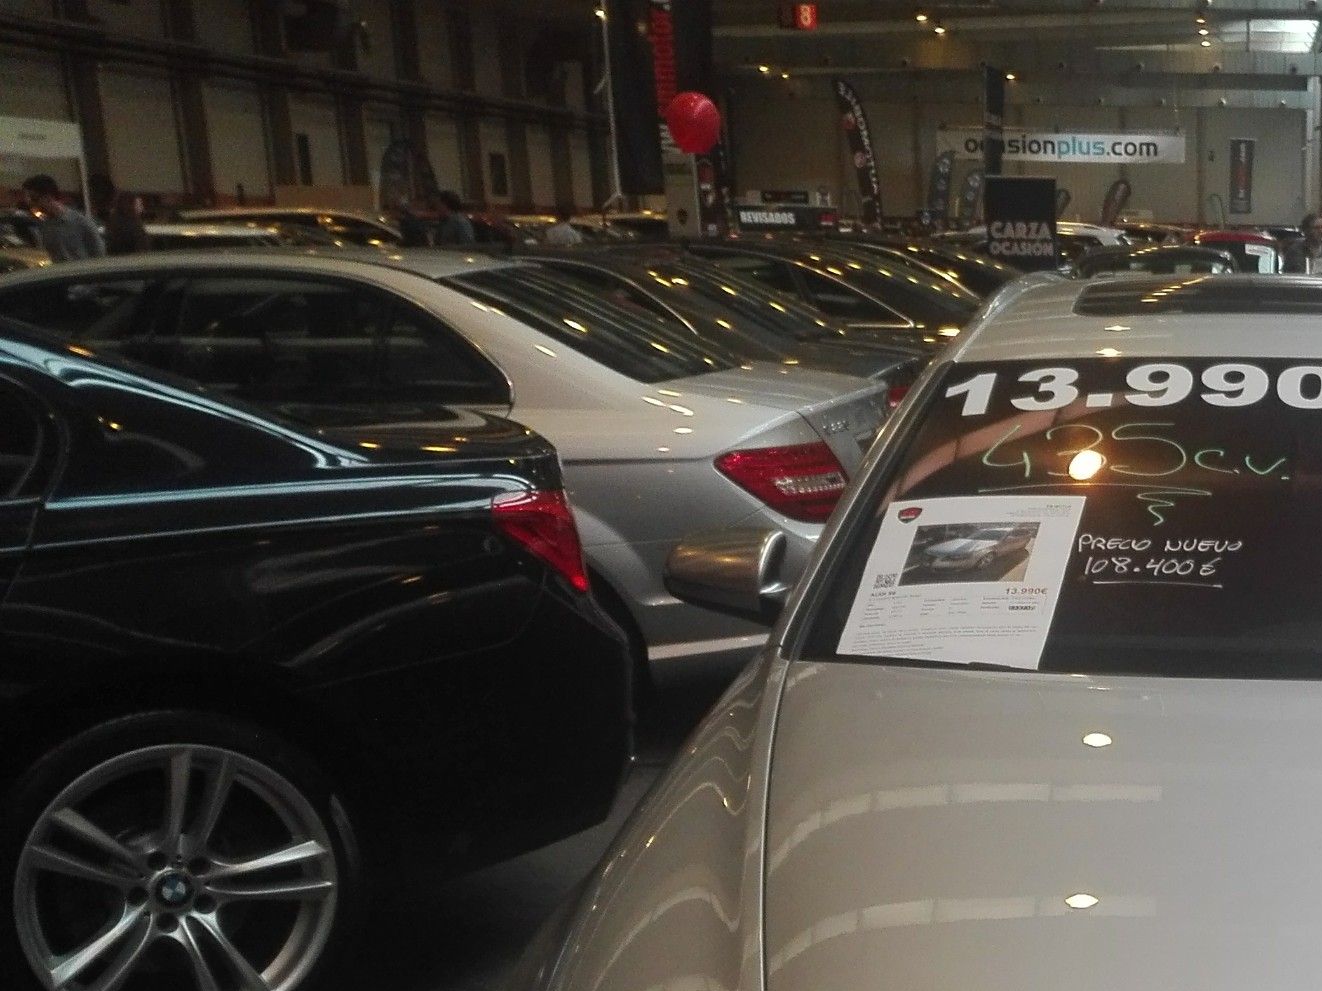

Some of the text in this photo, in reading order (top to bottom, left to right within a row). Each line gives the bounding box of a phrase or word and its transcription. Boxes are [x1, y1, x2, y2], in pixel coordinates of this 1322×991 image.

[964, 134, 1158, 158] osionplus.com
[740, 211, 796, 224] REVISADOS
[991, 221, 1051, 240] CARZA
[1164, 539, 1242, 553] NUEVO
